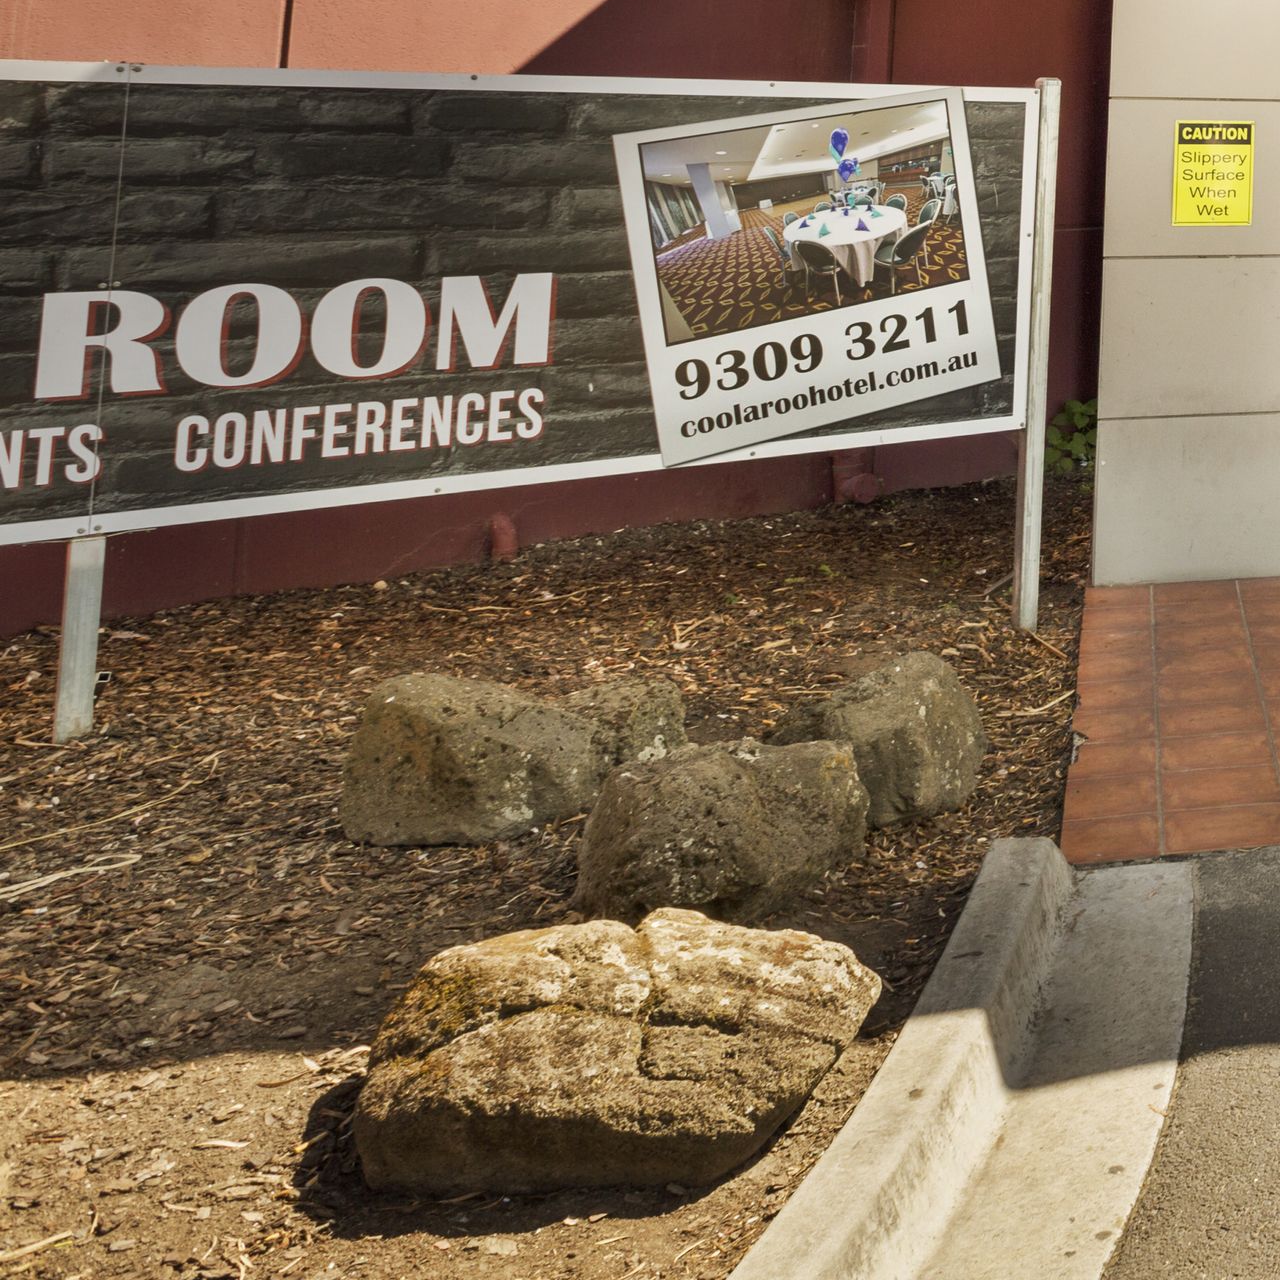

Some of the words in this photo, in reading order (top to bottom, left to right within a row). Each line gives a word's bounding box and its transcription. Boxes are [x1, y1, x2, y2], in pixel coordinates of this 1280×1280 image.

[1181, 127, 1248, 140] CAUTION
[1181, 151, 1248, 166] Slippery
[1182, 168, 1245, 181] Surface
[1189, 186, 1237, 198] When
[1197, 204, 1229, 216] Wet
[35, 272, 557, 401] ROOM
[675, 332, 824, 402] 9309
[845, 299, 970, 361] 3211
[680, 351, 979, 438] coolaroohotel.com.au
[174, 387, 547, 473] CONFERENCES
